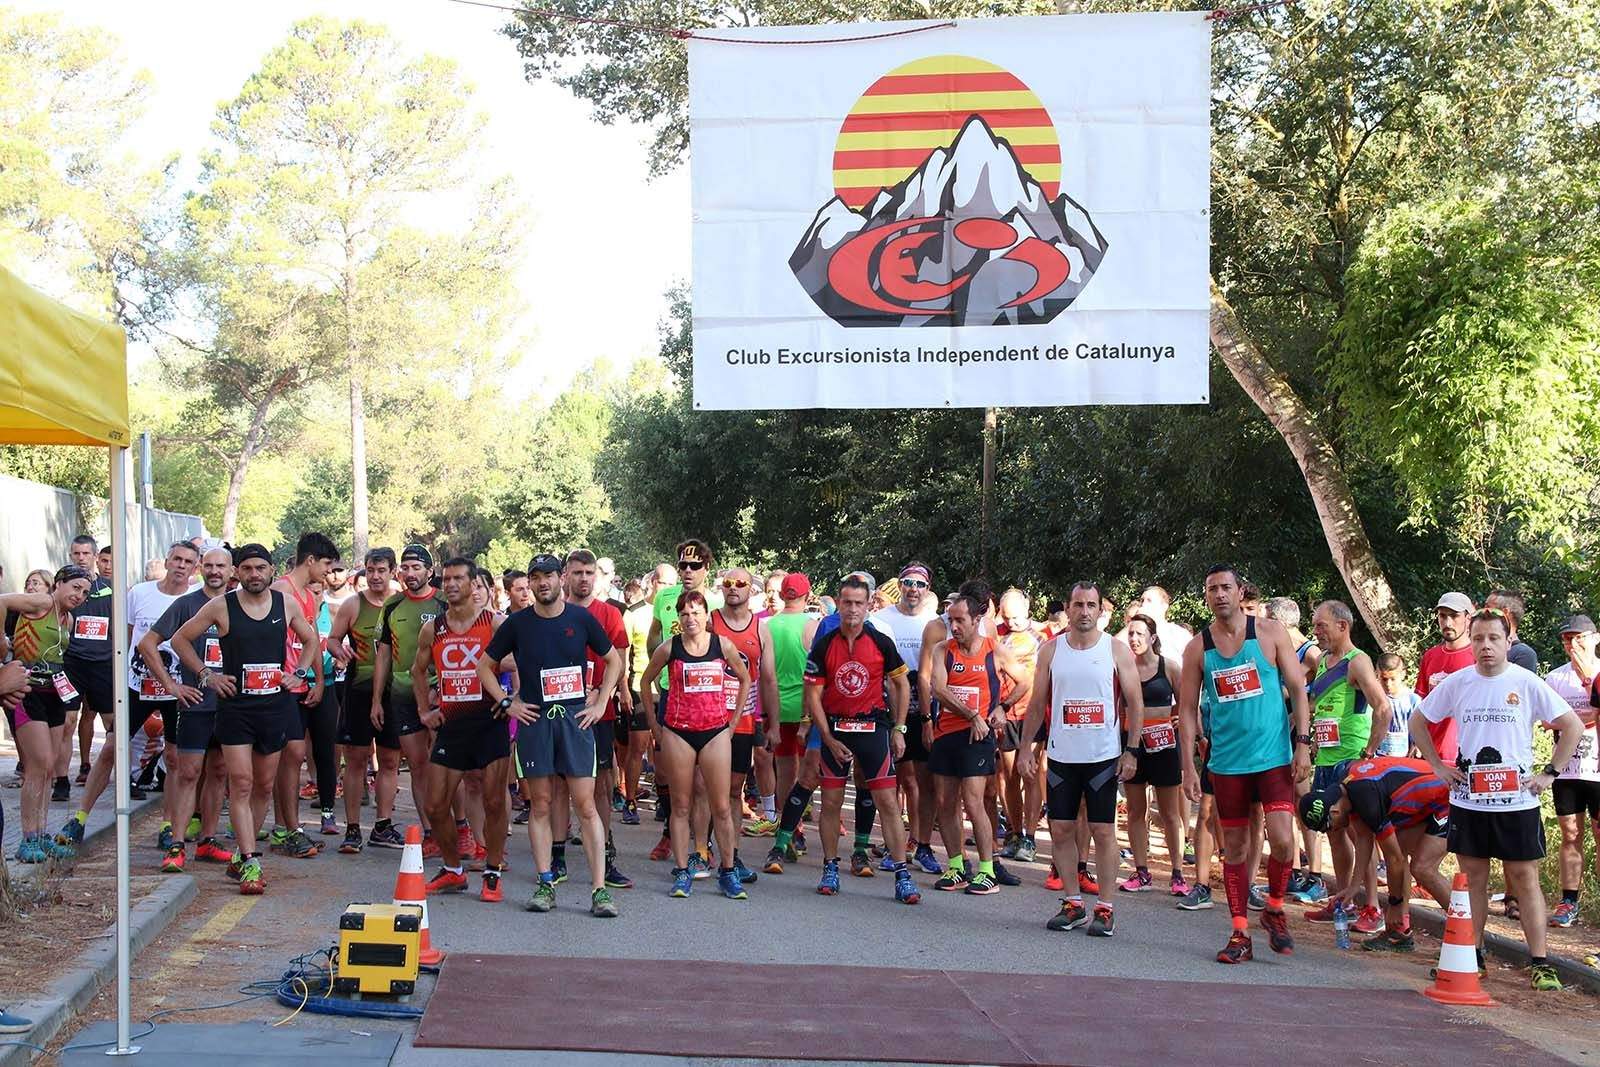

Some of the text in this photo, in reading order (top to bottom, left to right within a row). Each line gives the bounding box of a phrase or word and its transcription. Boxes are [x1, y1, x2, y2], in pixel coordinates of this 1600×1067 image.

[726, 342, 1176, 367] Club Excursionista Independent de Catalunya
[441, 643, 481, 669] CX
[257, 672, 275, 680] JAVI
[550, 674, 578, 685] CARLOS
[697, 676, 714, 686] 122
[1225, 672, 1250, 685] SERGI
[263, 680, 270, 688] 2
[451, 678, 472, 687] JULIO
[1233, 682, 1247, 693] 11
[154, 687, 166, 695] 52
[455, 686, 468, 695] 19
[558, 683, 574, 694] 149
[1068, 706, 1101, 714] EVARISTO
[1078, 714, 1091, 723] 35
[1462, 714, 1517, 724] LA FLORESTA
[1150, 730, 1169, 739] GRETA
[1154, 738, 1169, 746] 143
[1483, 772, 1507, 782] JOAN
[1488, 781, 1503, 792] 59
